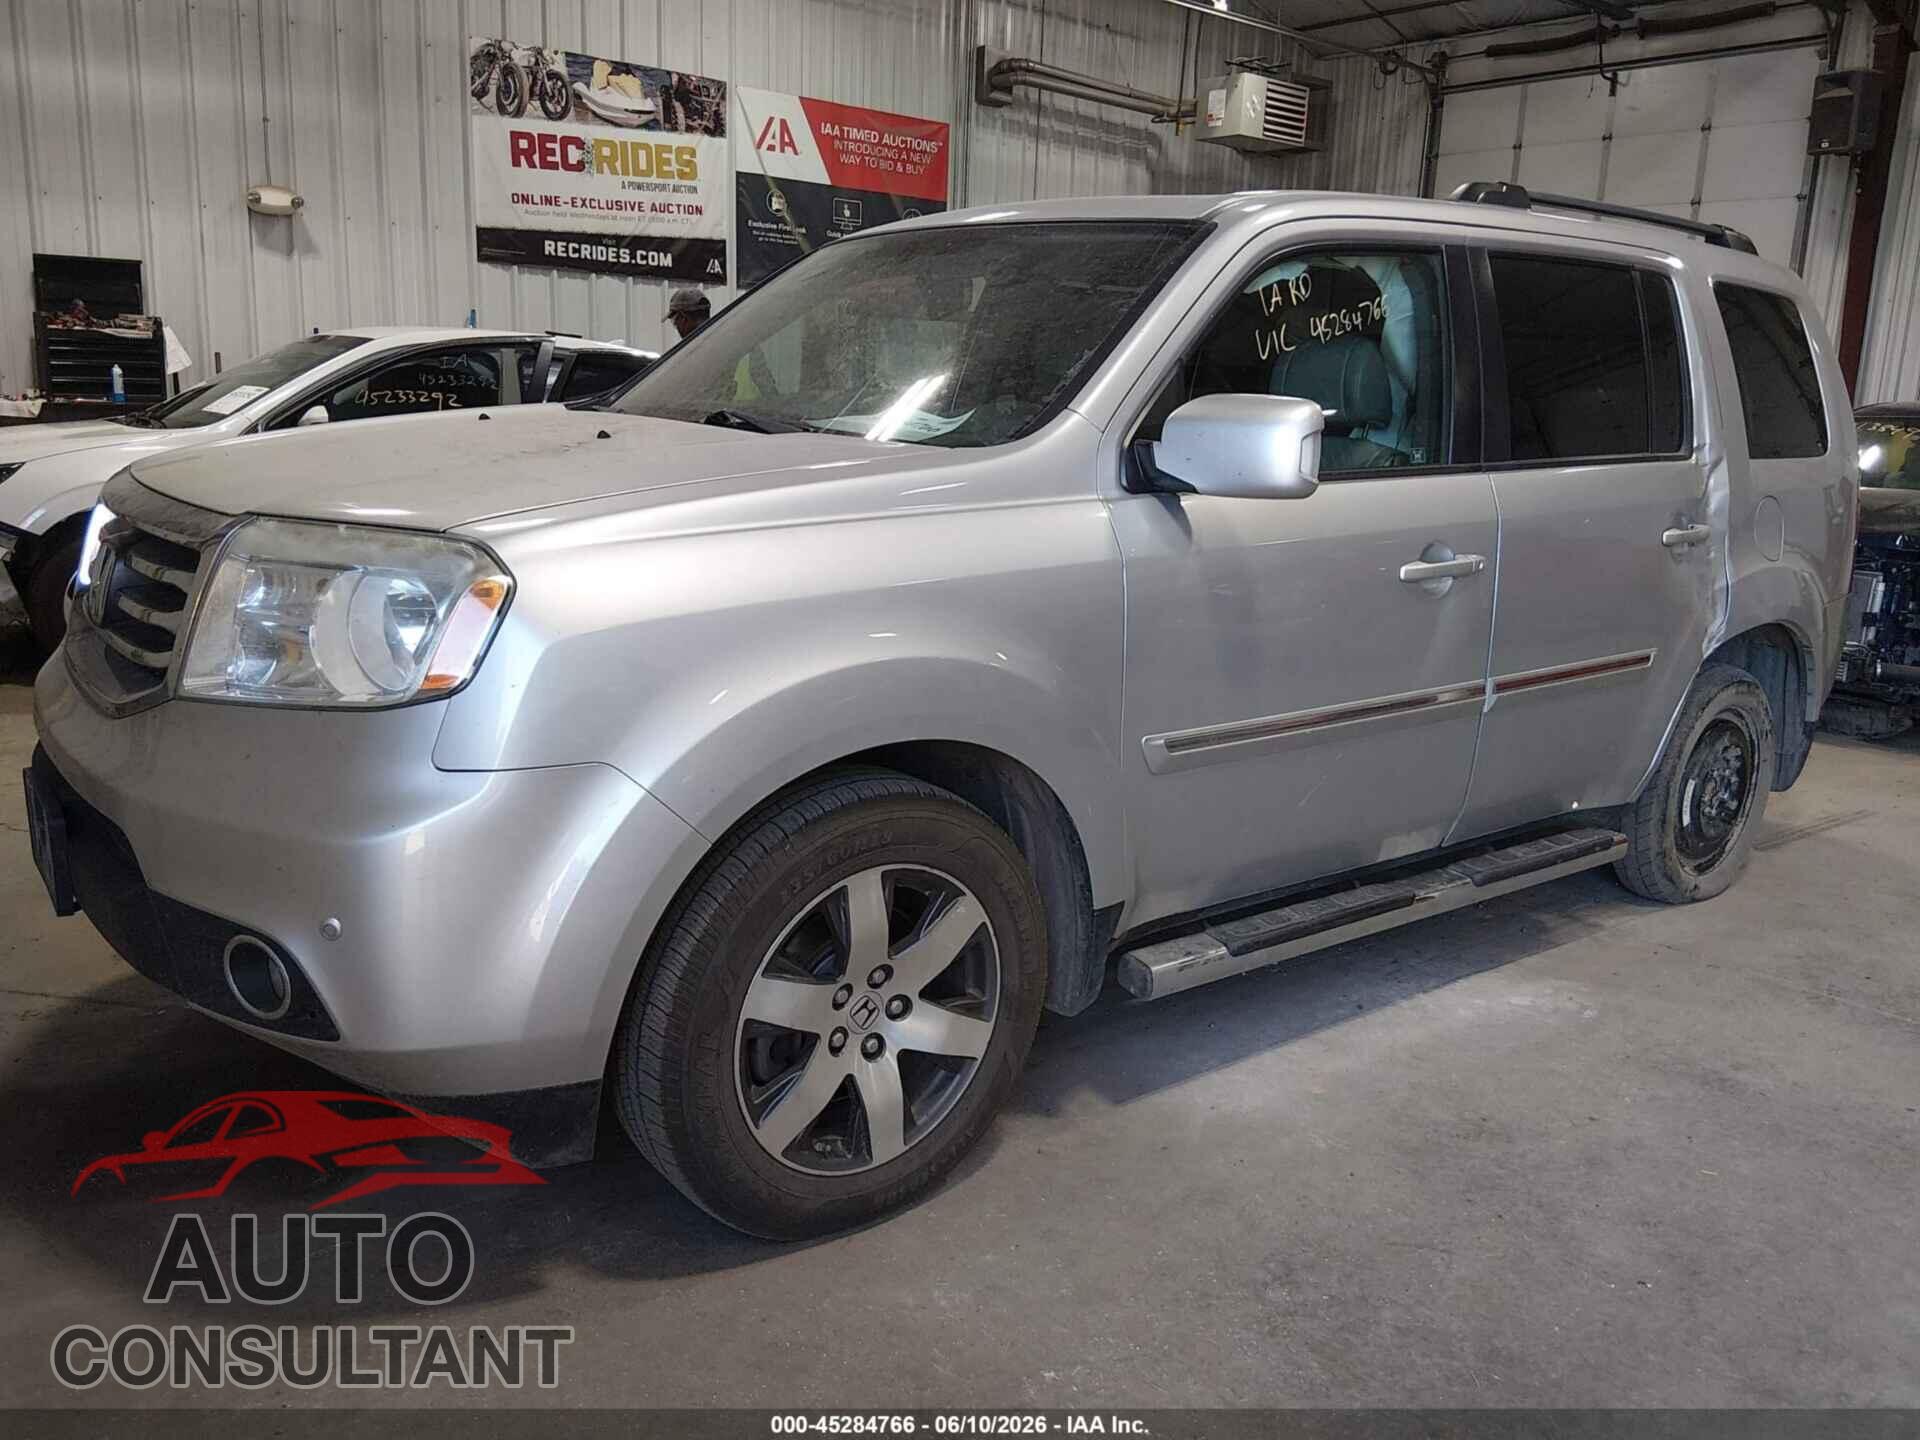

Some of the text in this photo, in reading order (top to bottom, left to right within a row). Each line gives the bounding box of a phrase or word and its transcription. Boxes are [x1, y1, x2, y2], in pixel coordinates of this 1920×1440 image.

[821, 122, 841, 137] IAA
[841, 127, 879, 143] TIMED
[592, 138, 698, 181] RIDES
[834, 141, 932, 165] INTRODUCING A NEW
[840, 153, 926, 175] WAY TO BID & BUY
[621, 180, 699, 194] A POWERSPORT AUCTION
[511, 192, 704, 216] ONLINE-EXCLUSIVE AUCTION
[544, 240, 673, 268] RECRIDES.COM
[1309, 294, 1390, 345] 45284766
[354, 388, 463, 411] 45233292
